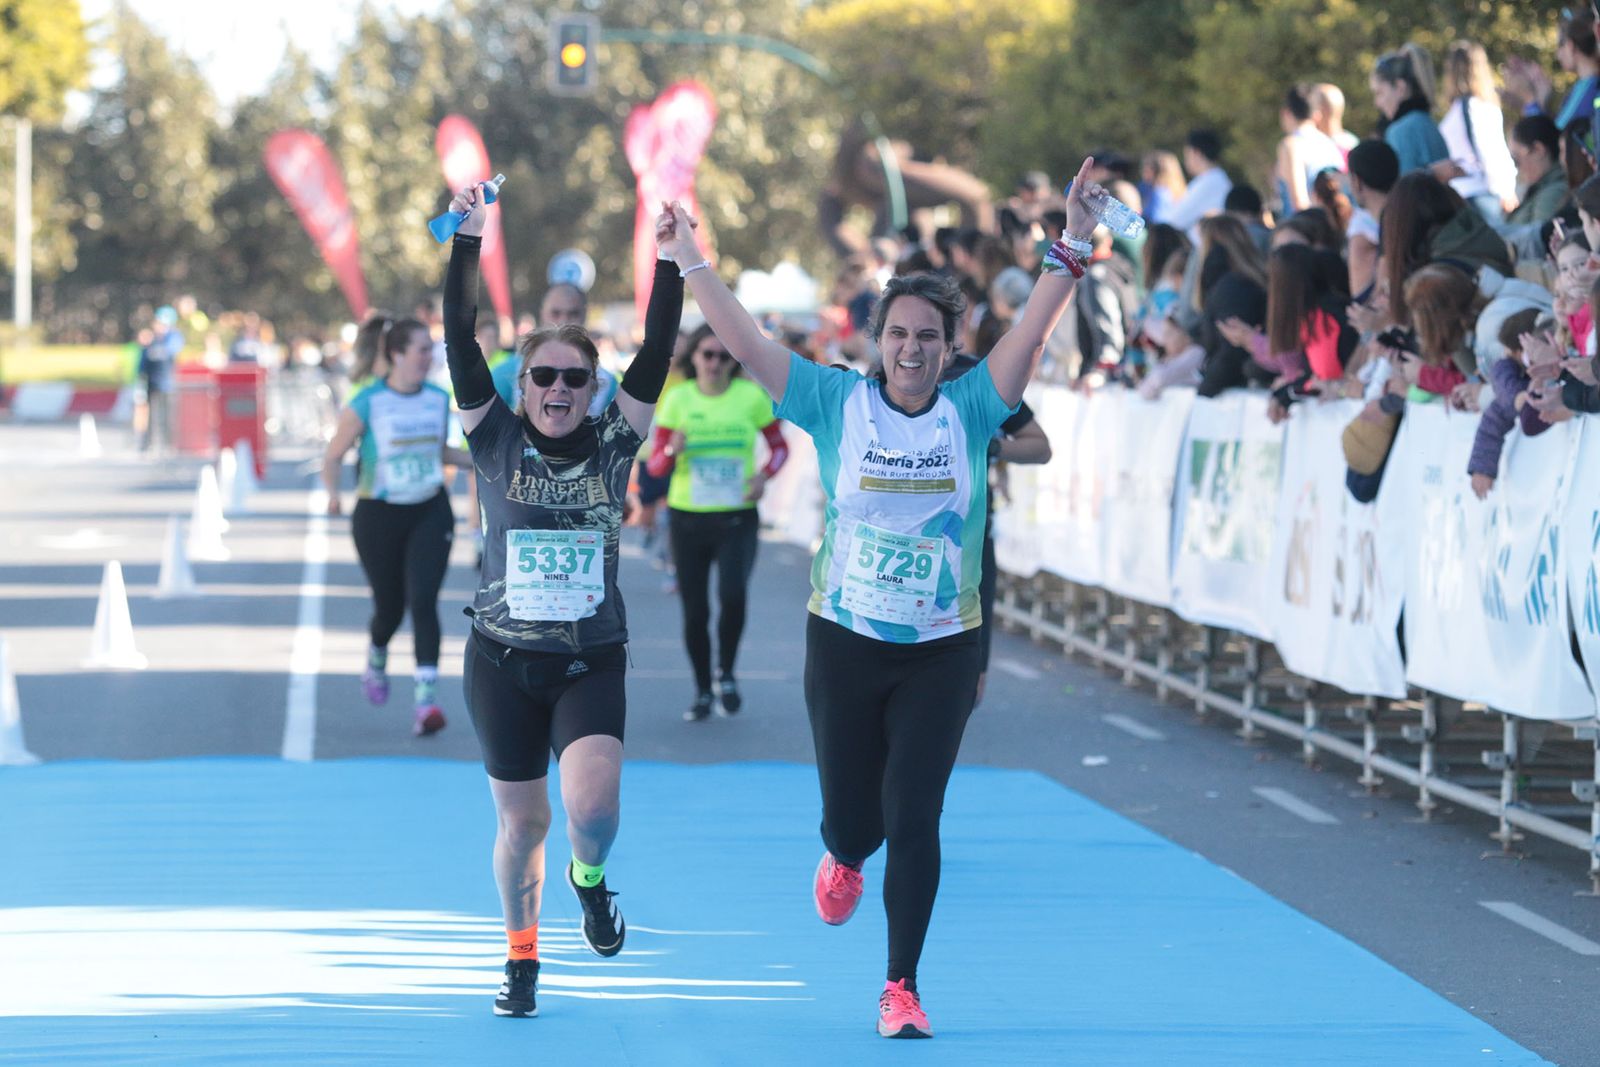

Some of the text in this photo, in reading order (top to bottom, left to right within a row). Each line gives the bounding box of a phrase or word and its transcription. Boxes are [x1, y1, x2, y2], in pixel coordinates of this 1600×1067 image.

[862, 450, 914, 469] Almería
[506, 484, 588, 505] FOREVER
[518, 546, 595, 575] 5337
[858, 541, 933, 580] 5729
[544, 573, 570, 581] NINES
[876, 573, 904, 585] LAURA
